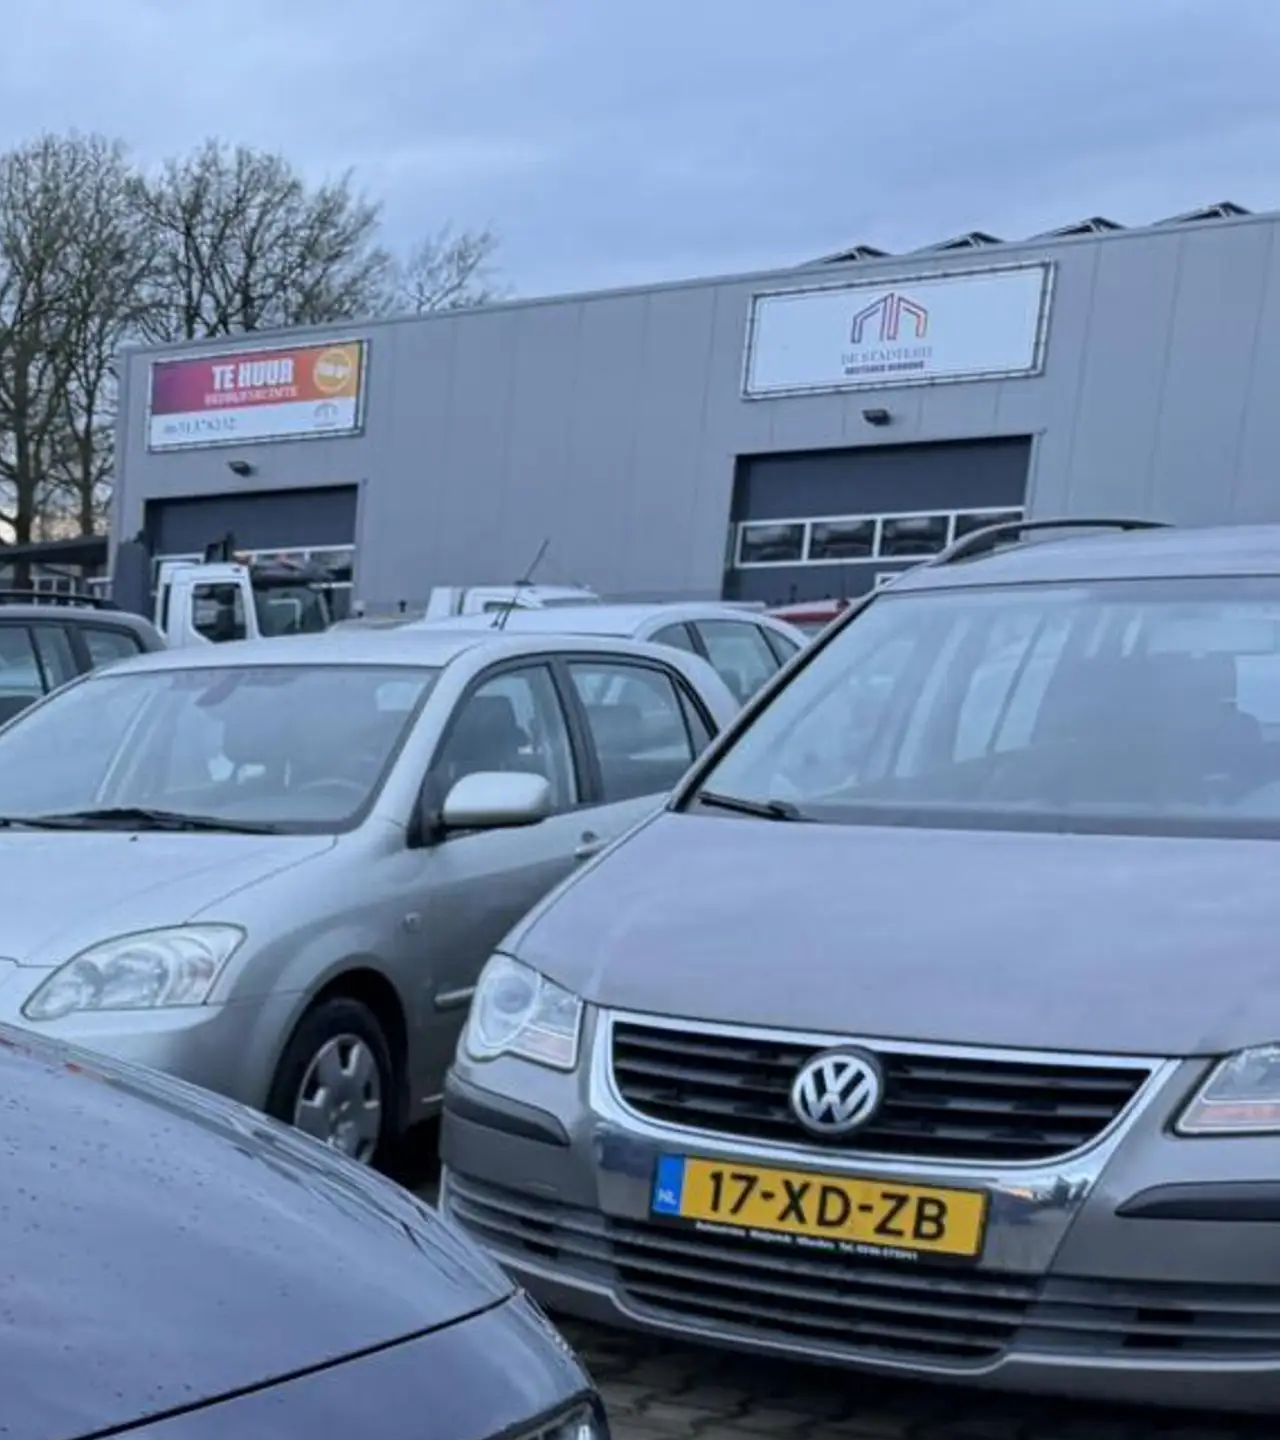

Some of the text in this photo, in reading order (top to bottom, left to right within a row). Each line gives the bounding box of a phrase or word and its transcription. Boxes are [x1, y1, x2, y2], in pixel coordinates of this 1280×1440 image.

[211, 365, 235, 391] TE
[238, 358, 294, 388] HUUR
[709, 1171, 948, 1241] 17-XD-ZB
